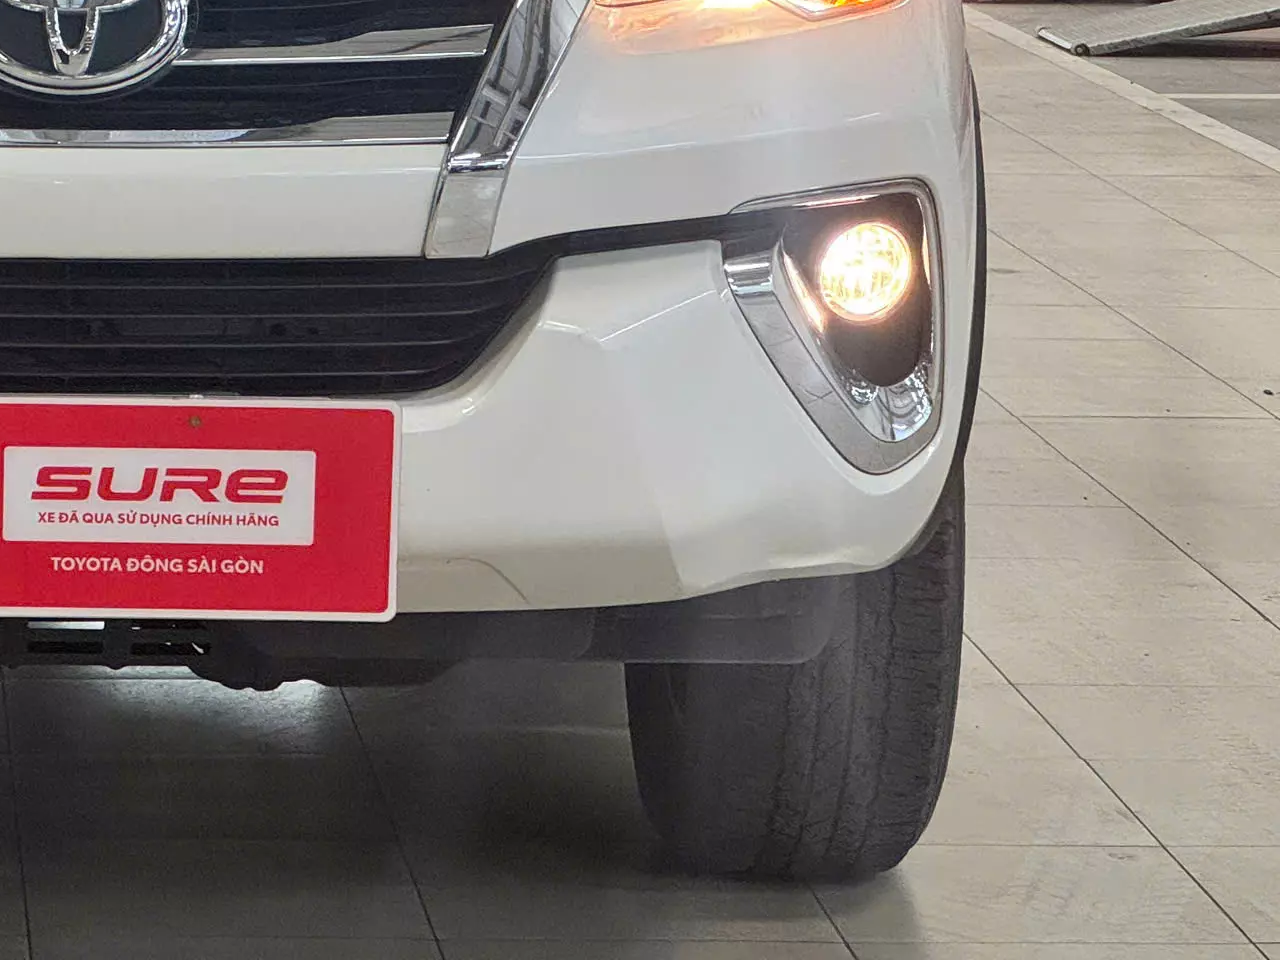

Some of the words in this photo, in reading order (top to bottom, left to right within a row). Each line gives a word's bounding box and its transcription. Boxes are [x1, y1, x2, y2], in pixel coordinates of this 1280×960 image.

[38, 512, 55, 523] XE
[58, 509, 79, 523] ĐÃ
[82, 512, 114, 524] QUA
[117, 509, 137, 524] SỬ
[140, 513, 183, 528] DỤNG
[186, 511, 232, 526] CHÍNH
[236, 512, 280, 527] HÃNG
[51, 556, 123, 572] TOYOTA
[126, 554, 183, 573] ĐÔNG
[187, 555, 217, 573] SÀI
[220, 556, 264, 574] GÒN
